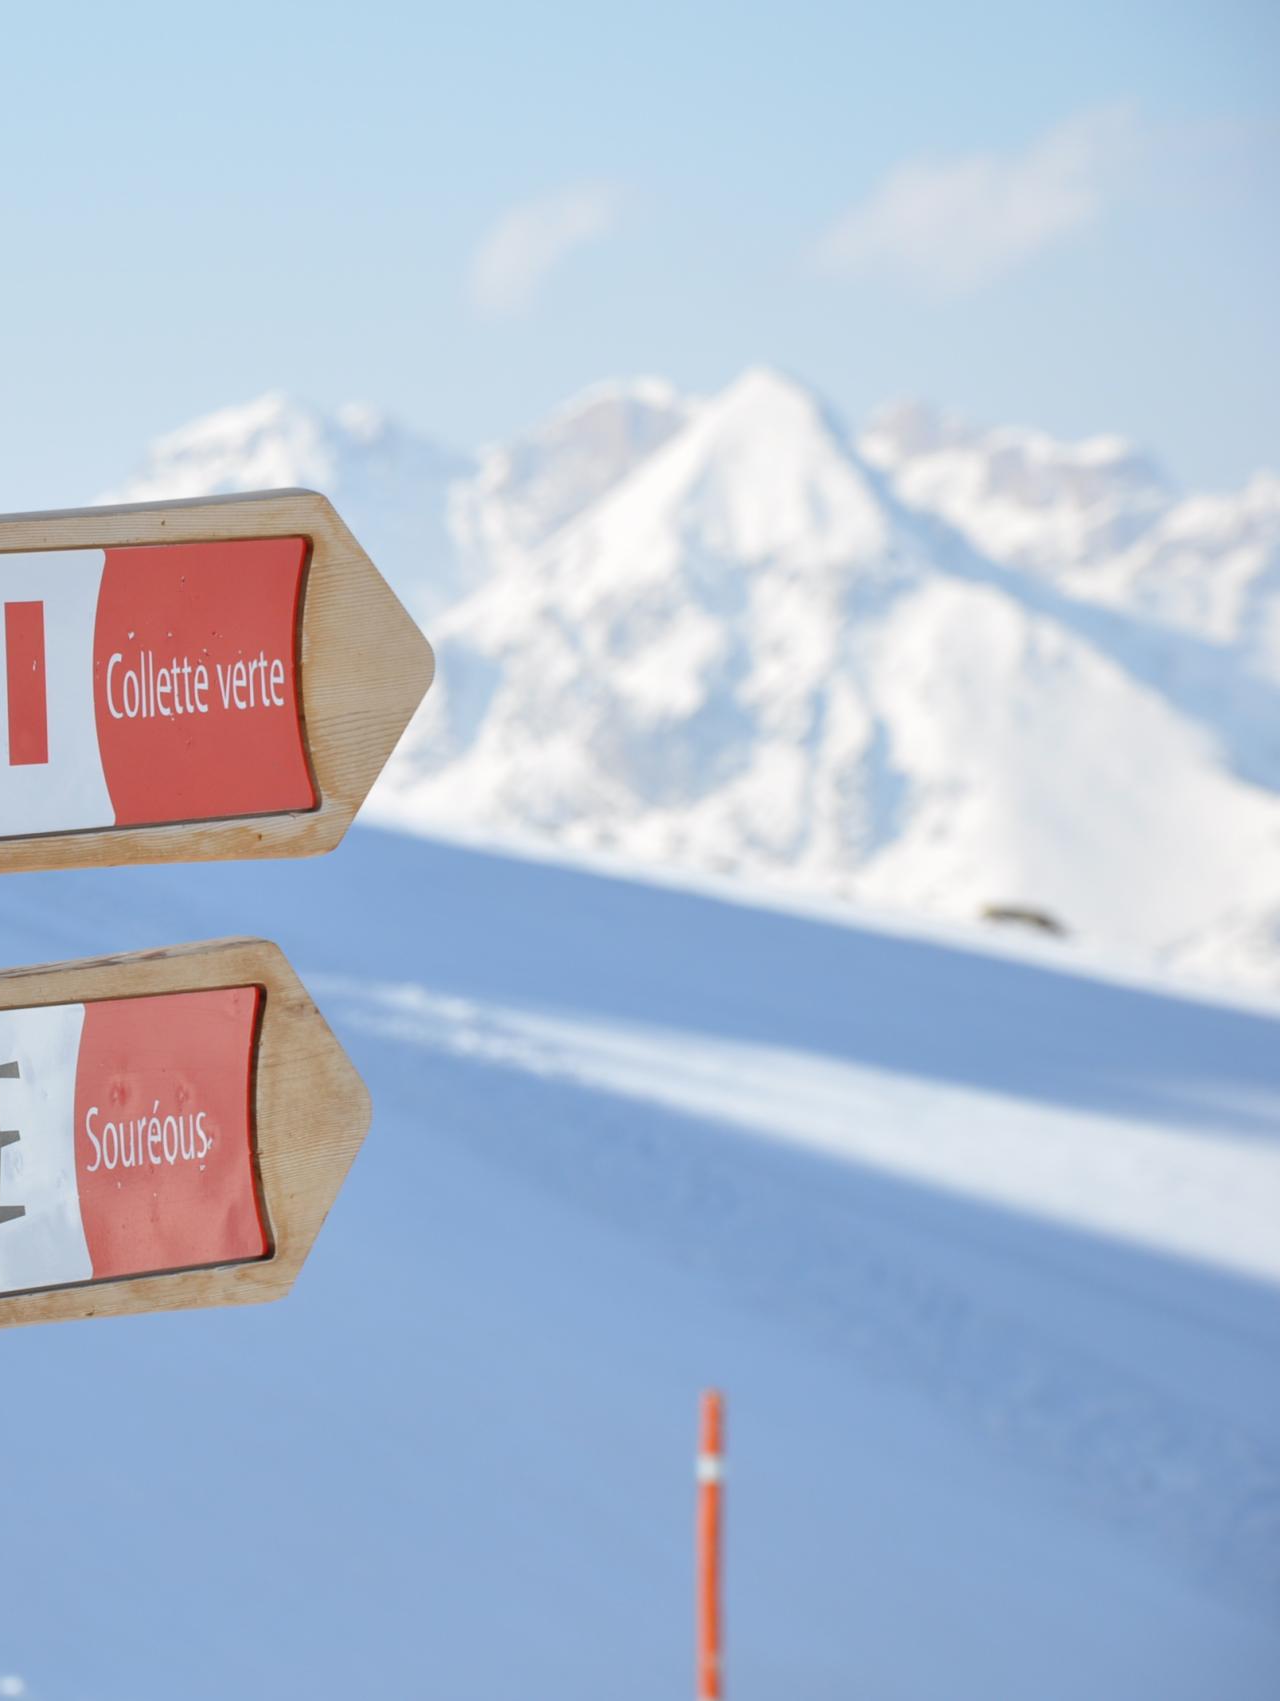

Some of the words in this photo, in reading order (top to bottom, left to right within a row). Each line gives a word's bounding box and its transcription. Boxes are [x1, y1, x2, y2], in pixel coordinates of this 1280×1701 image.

[106, 650, 209, 719] Collette
[216, 651, 285, 711] verte
[86, 1100, 207, 1172] Souréous
